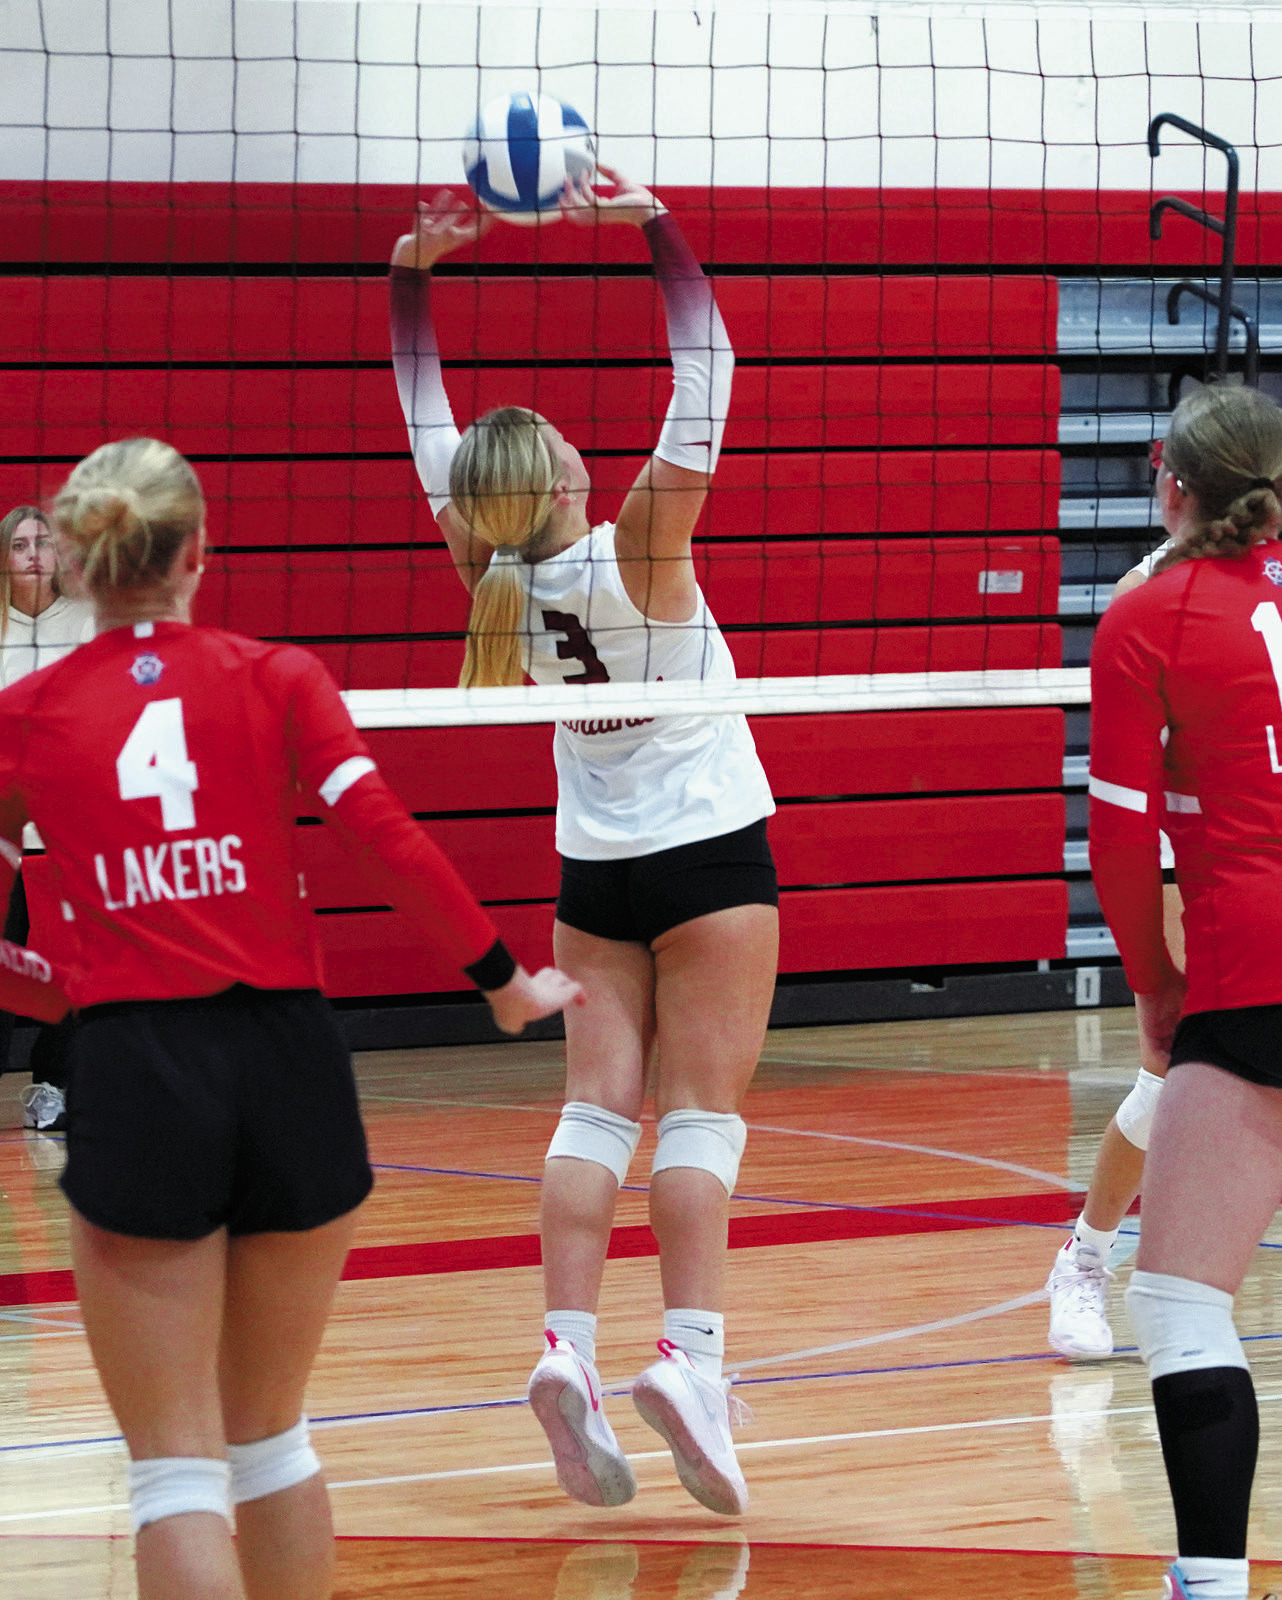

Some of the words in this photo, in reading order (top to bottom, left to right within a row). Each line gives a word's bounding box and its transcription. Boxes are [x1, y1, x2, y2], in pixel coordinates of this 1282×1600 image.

[541, 610, 610, 684] 3
[116, 698, 199, 832] 4
[94, 834, 247, 911] LAKERS
